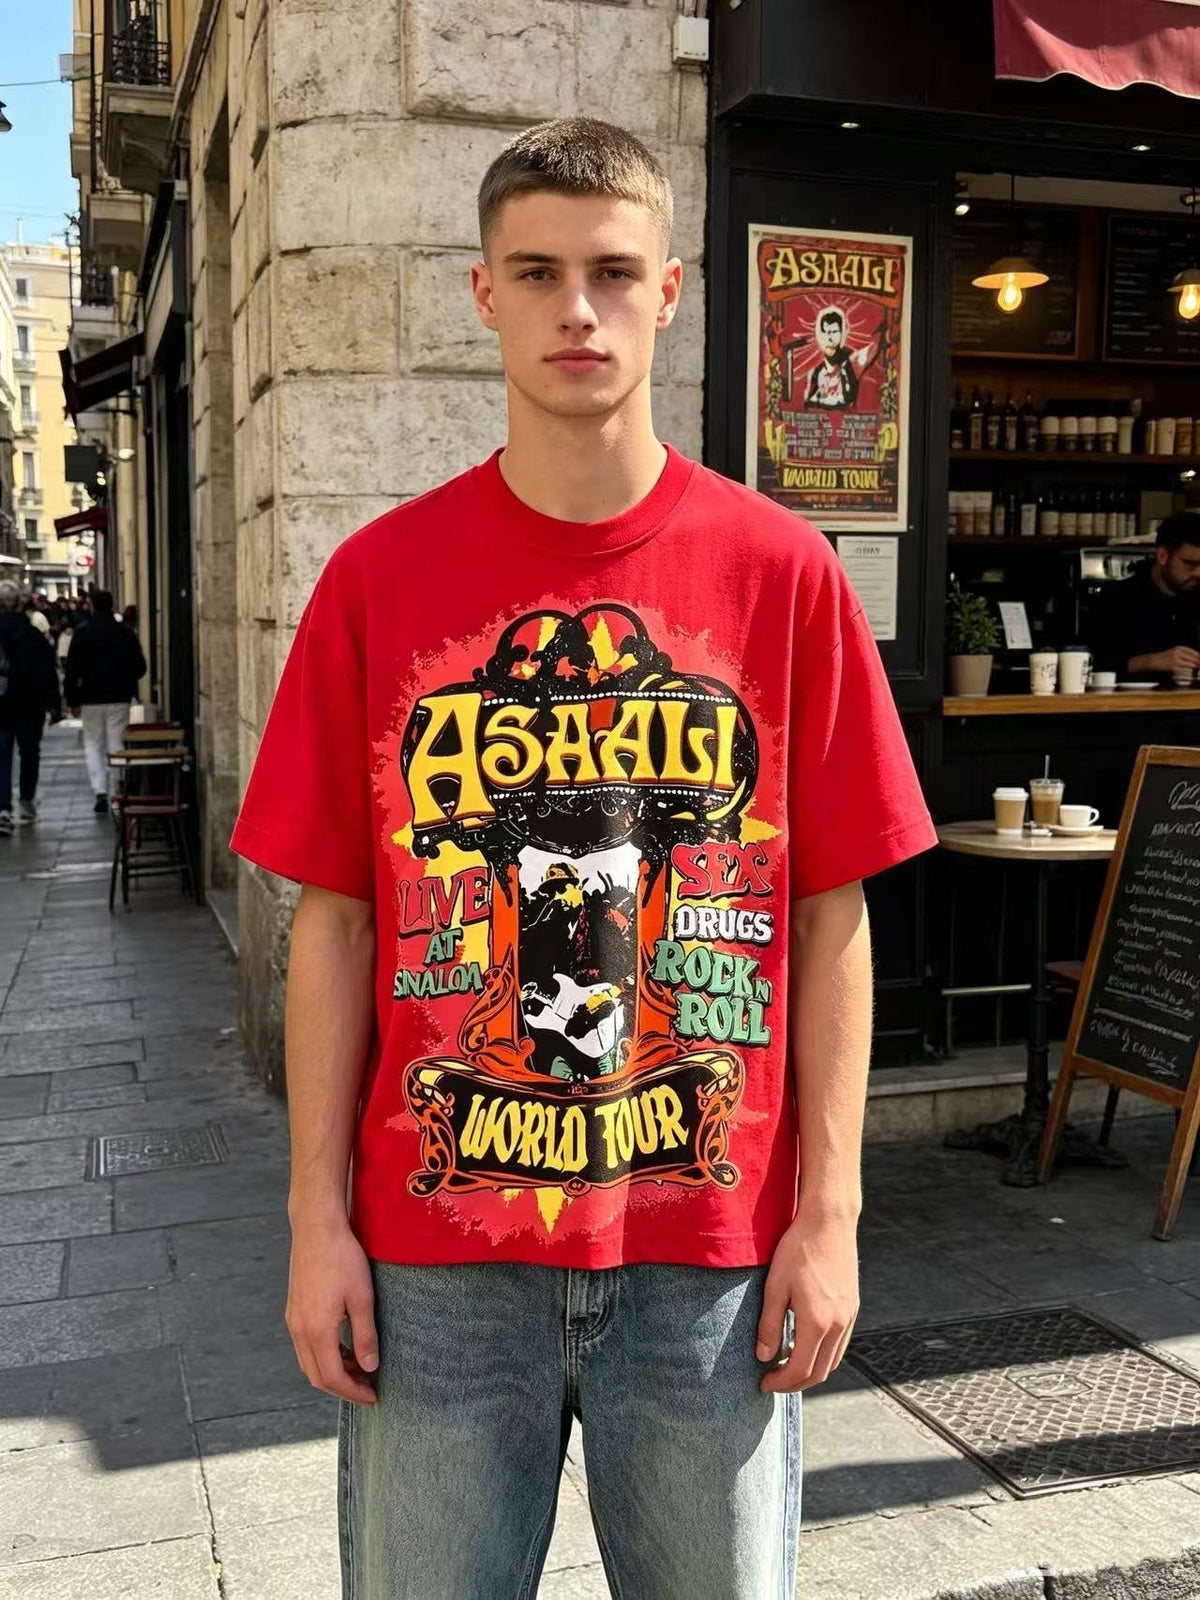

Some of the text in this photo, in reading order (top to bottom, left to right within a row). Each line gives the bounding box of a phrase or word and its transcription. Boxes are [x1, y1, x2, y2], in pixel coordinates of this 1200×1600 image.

[408, 692, 738, 831] ASAALI
[398, 866, 491, 939] LIVE
[671, 841, 773, 901] SEX
[424, 927, 463, 966] AT
[674, 904, 773, 946] DRUGS
[653, 939, 772, 1005] ROCK N
[674, 992, 771, 1047] ROLL
[459, 1084, 690, 1174] WORLD TOUR
